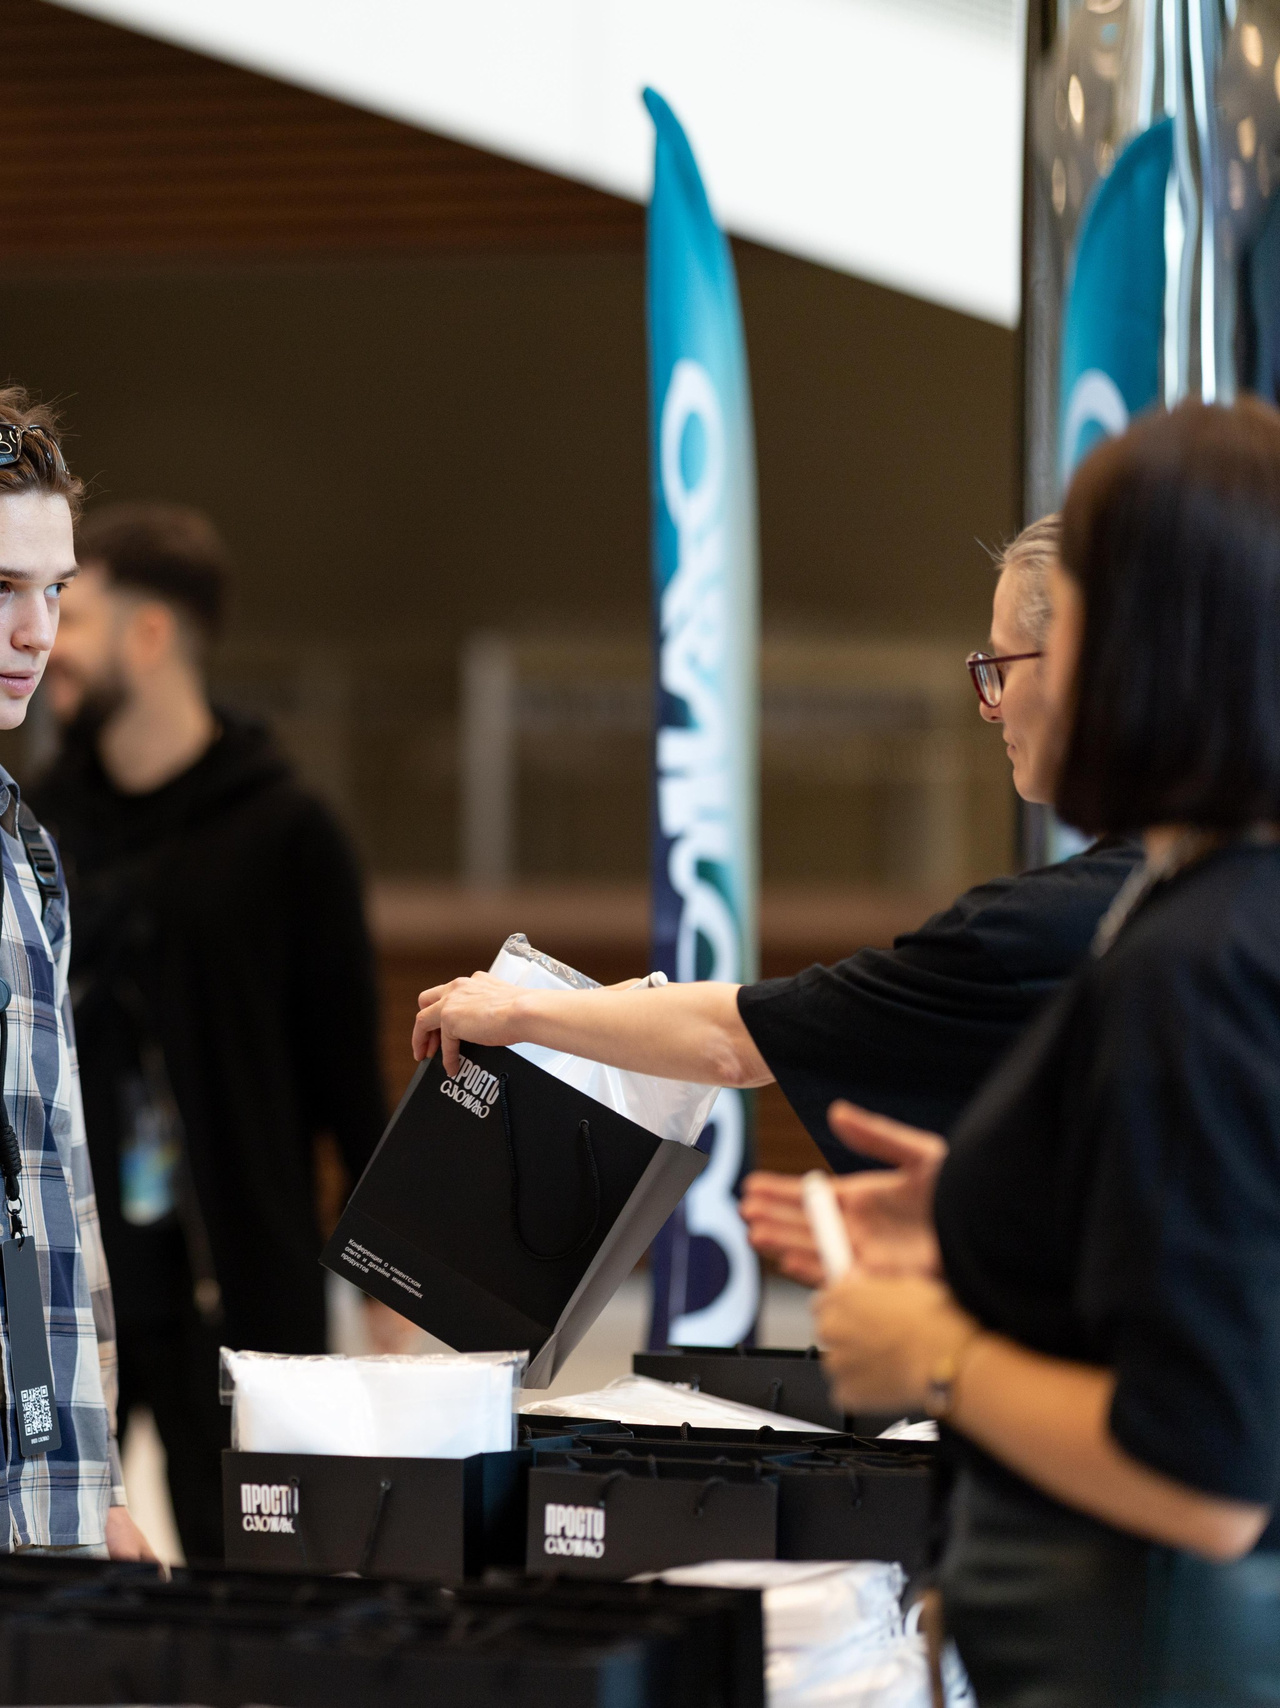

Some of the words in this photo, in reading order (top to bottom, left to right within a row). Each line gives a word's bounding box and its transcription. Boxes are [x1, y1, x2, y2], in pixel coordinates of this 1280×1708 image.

[447, 1054, 500, 1105] РОСТО
[341, 1252, 369, 1274] продуктов
[345, 1246, 361, 1259] опыте
[368, 1261, 391, 1278] дизайне
[392, 1276, 423, 1299] инженерных
[348, 1239, 383, 1264] Конференция
[390, 1266, 422, 1288] клиентском
[545, 1504, 605, 1540] ПРОСТО
